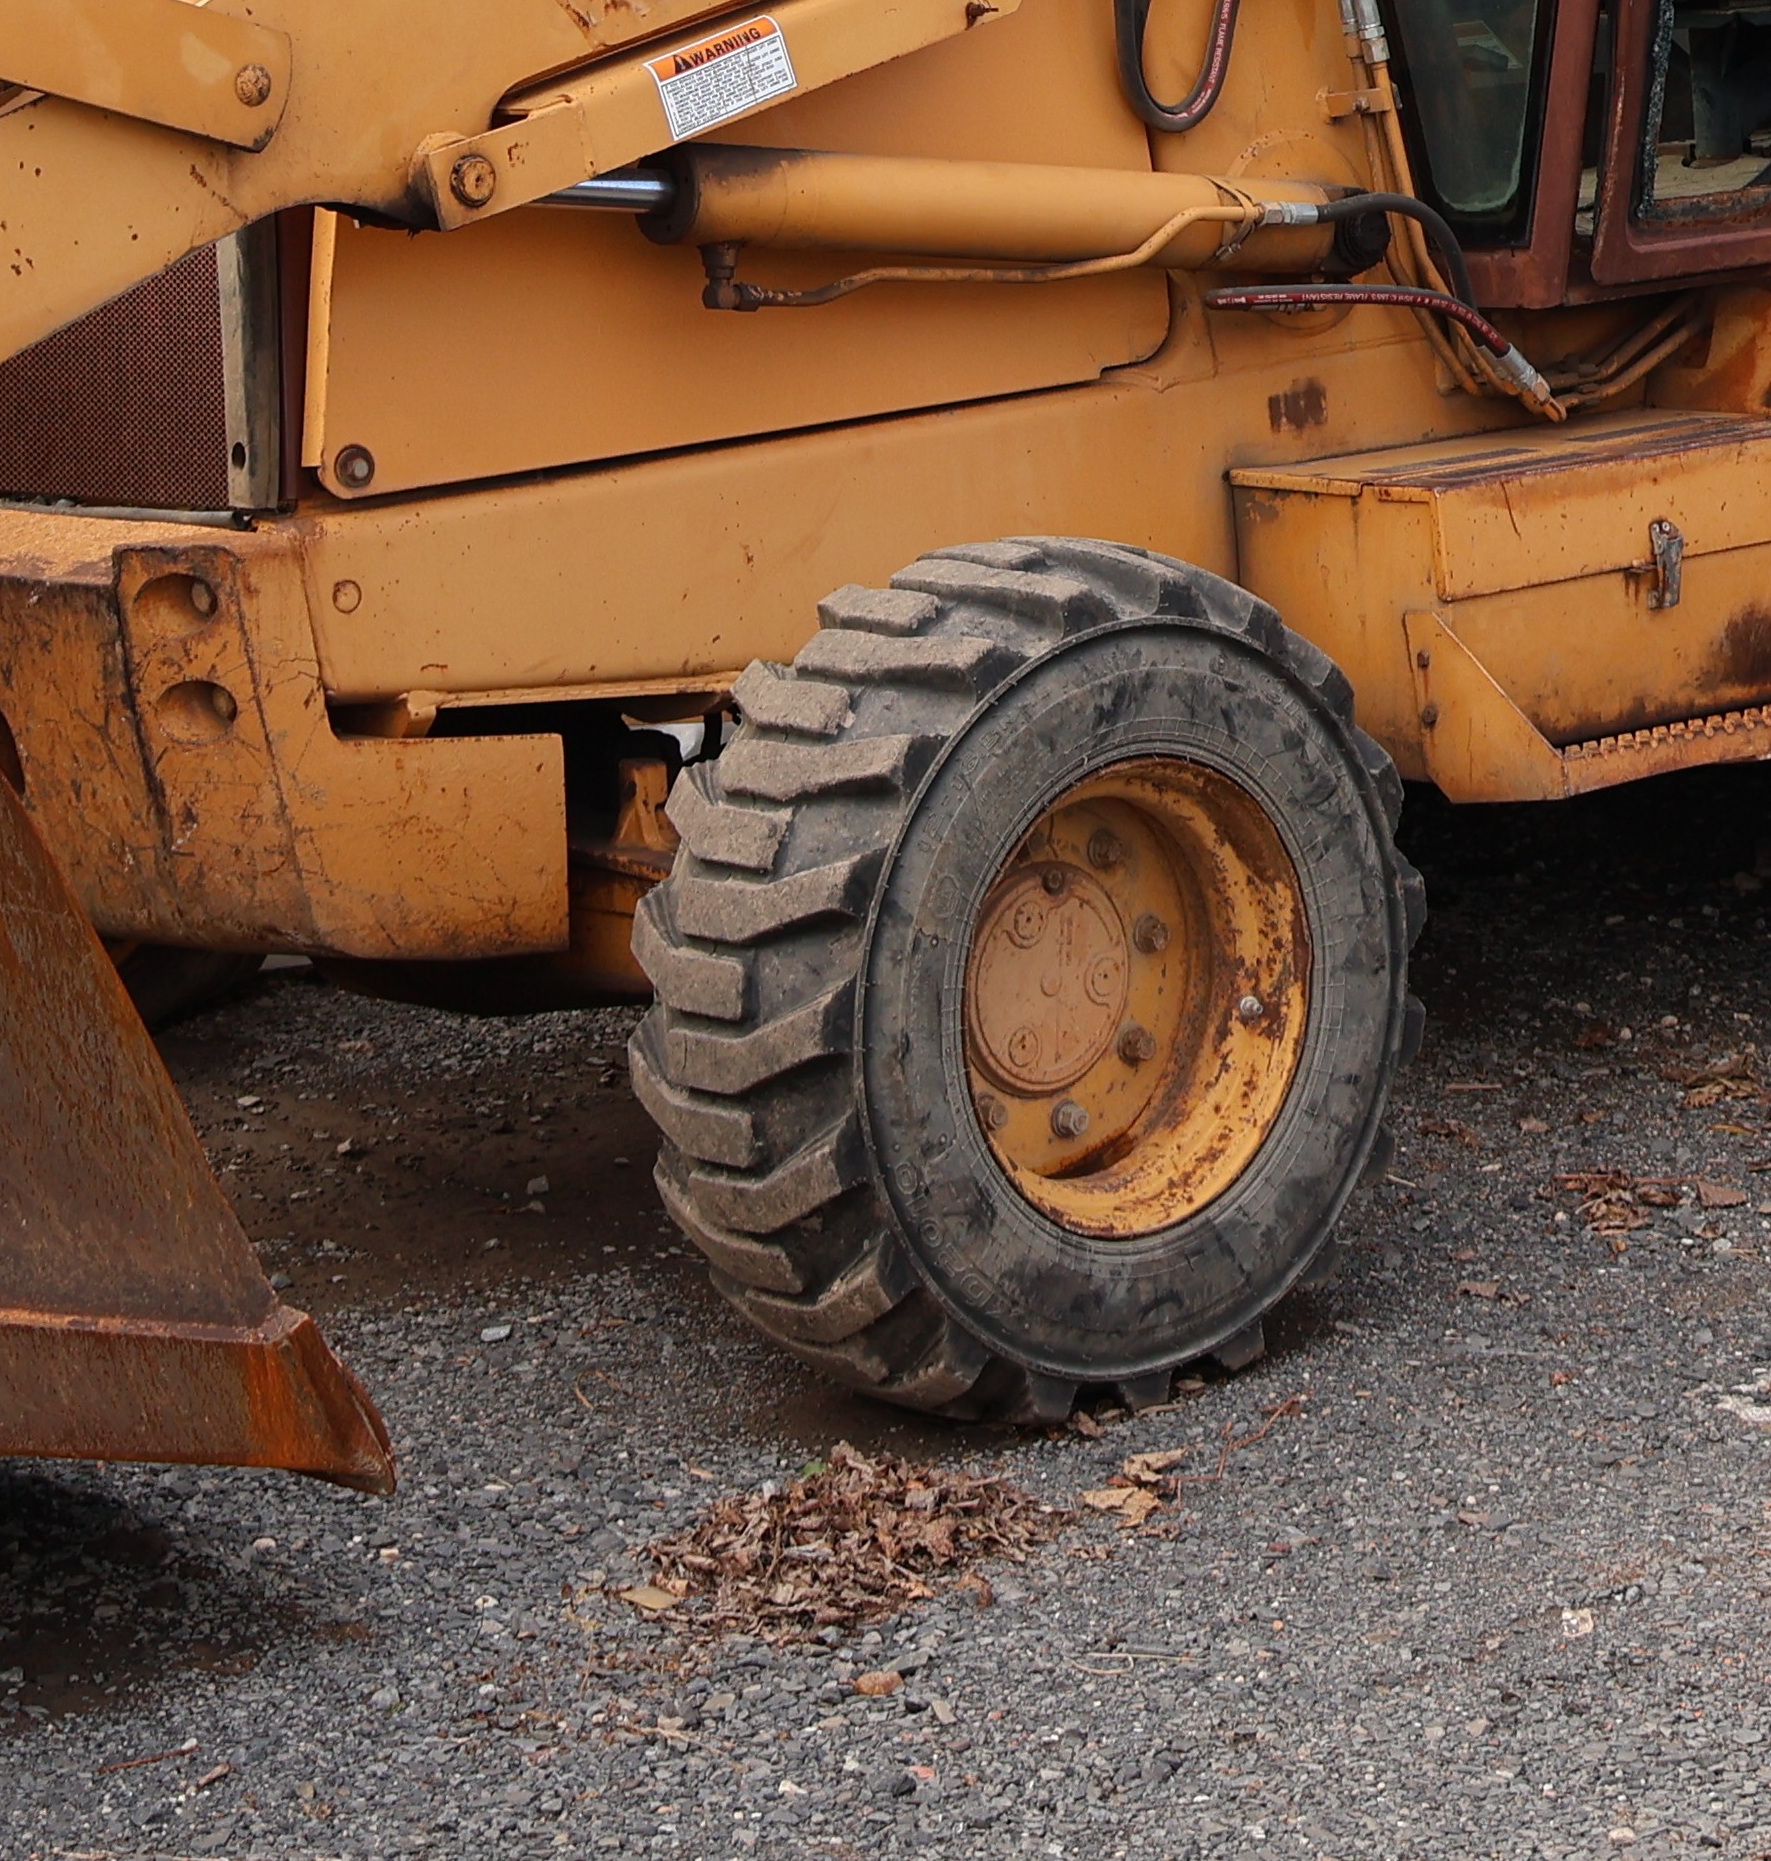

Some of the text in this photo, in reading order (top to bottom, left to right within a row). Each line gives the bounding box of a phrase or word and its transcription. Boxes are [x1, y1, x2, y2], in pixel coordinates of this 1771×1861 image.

[690, 27, 761, 66] WARNING
[1215, 22, 1227, 45] FLAME
[1207, 46, 1222, 83] RESISTANT
